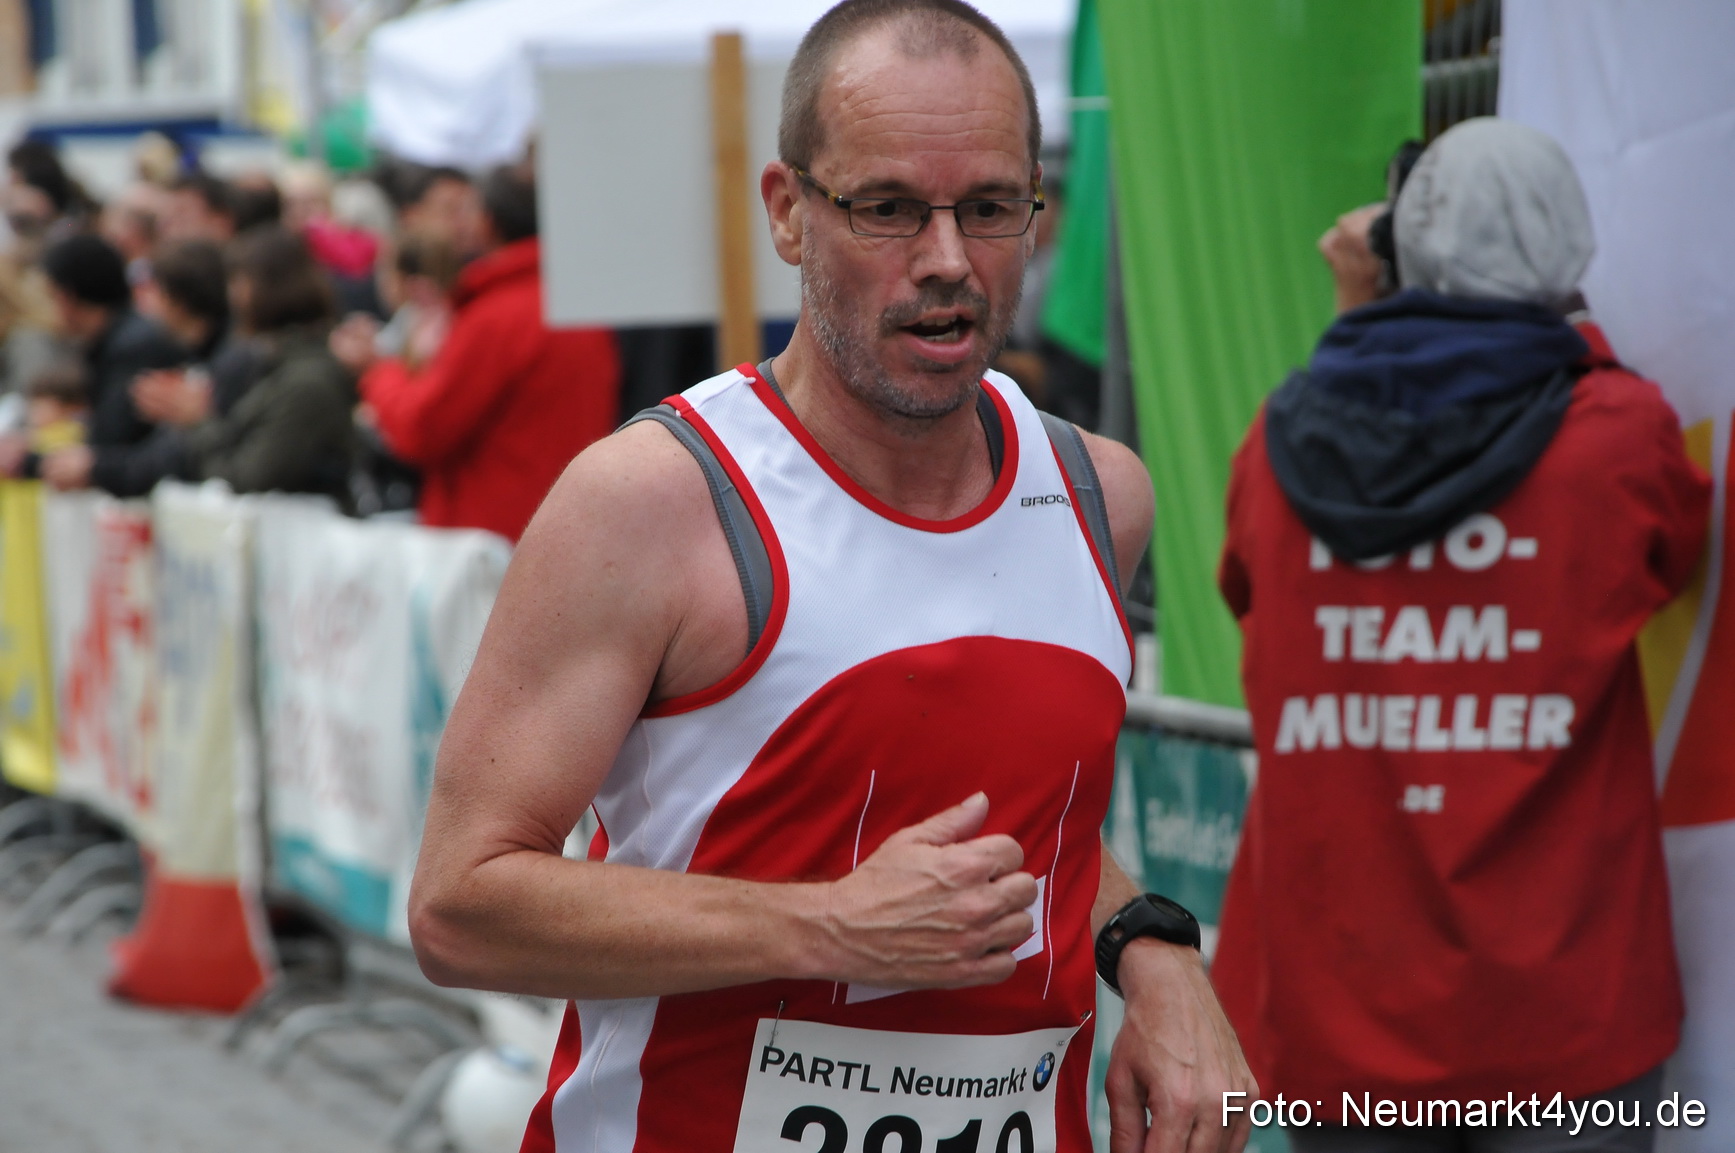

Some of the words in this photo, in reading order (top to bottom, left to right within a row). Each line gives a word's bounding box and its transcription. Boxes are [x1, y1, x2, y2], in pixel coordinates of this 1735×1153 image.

[1021, 494, 1070, 508] BROO
[1315, 605, 1541, 663] TEAM-
[1275, 693, 1575, 753] MUELLER
[759, 1045, 881, 1094] PARTL
[890, 1066, 1028, 1099] Neumarkt
